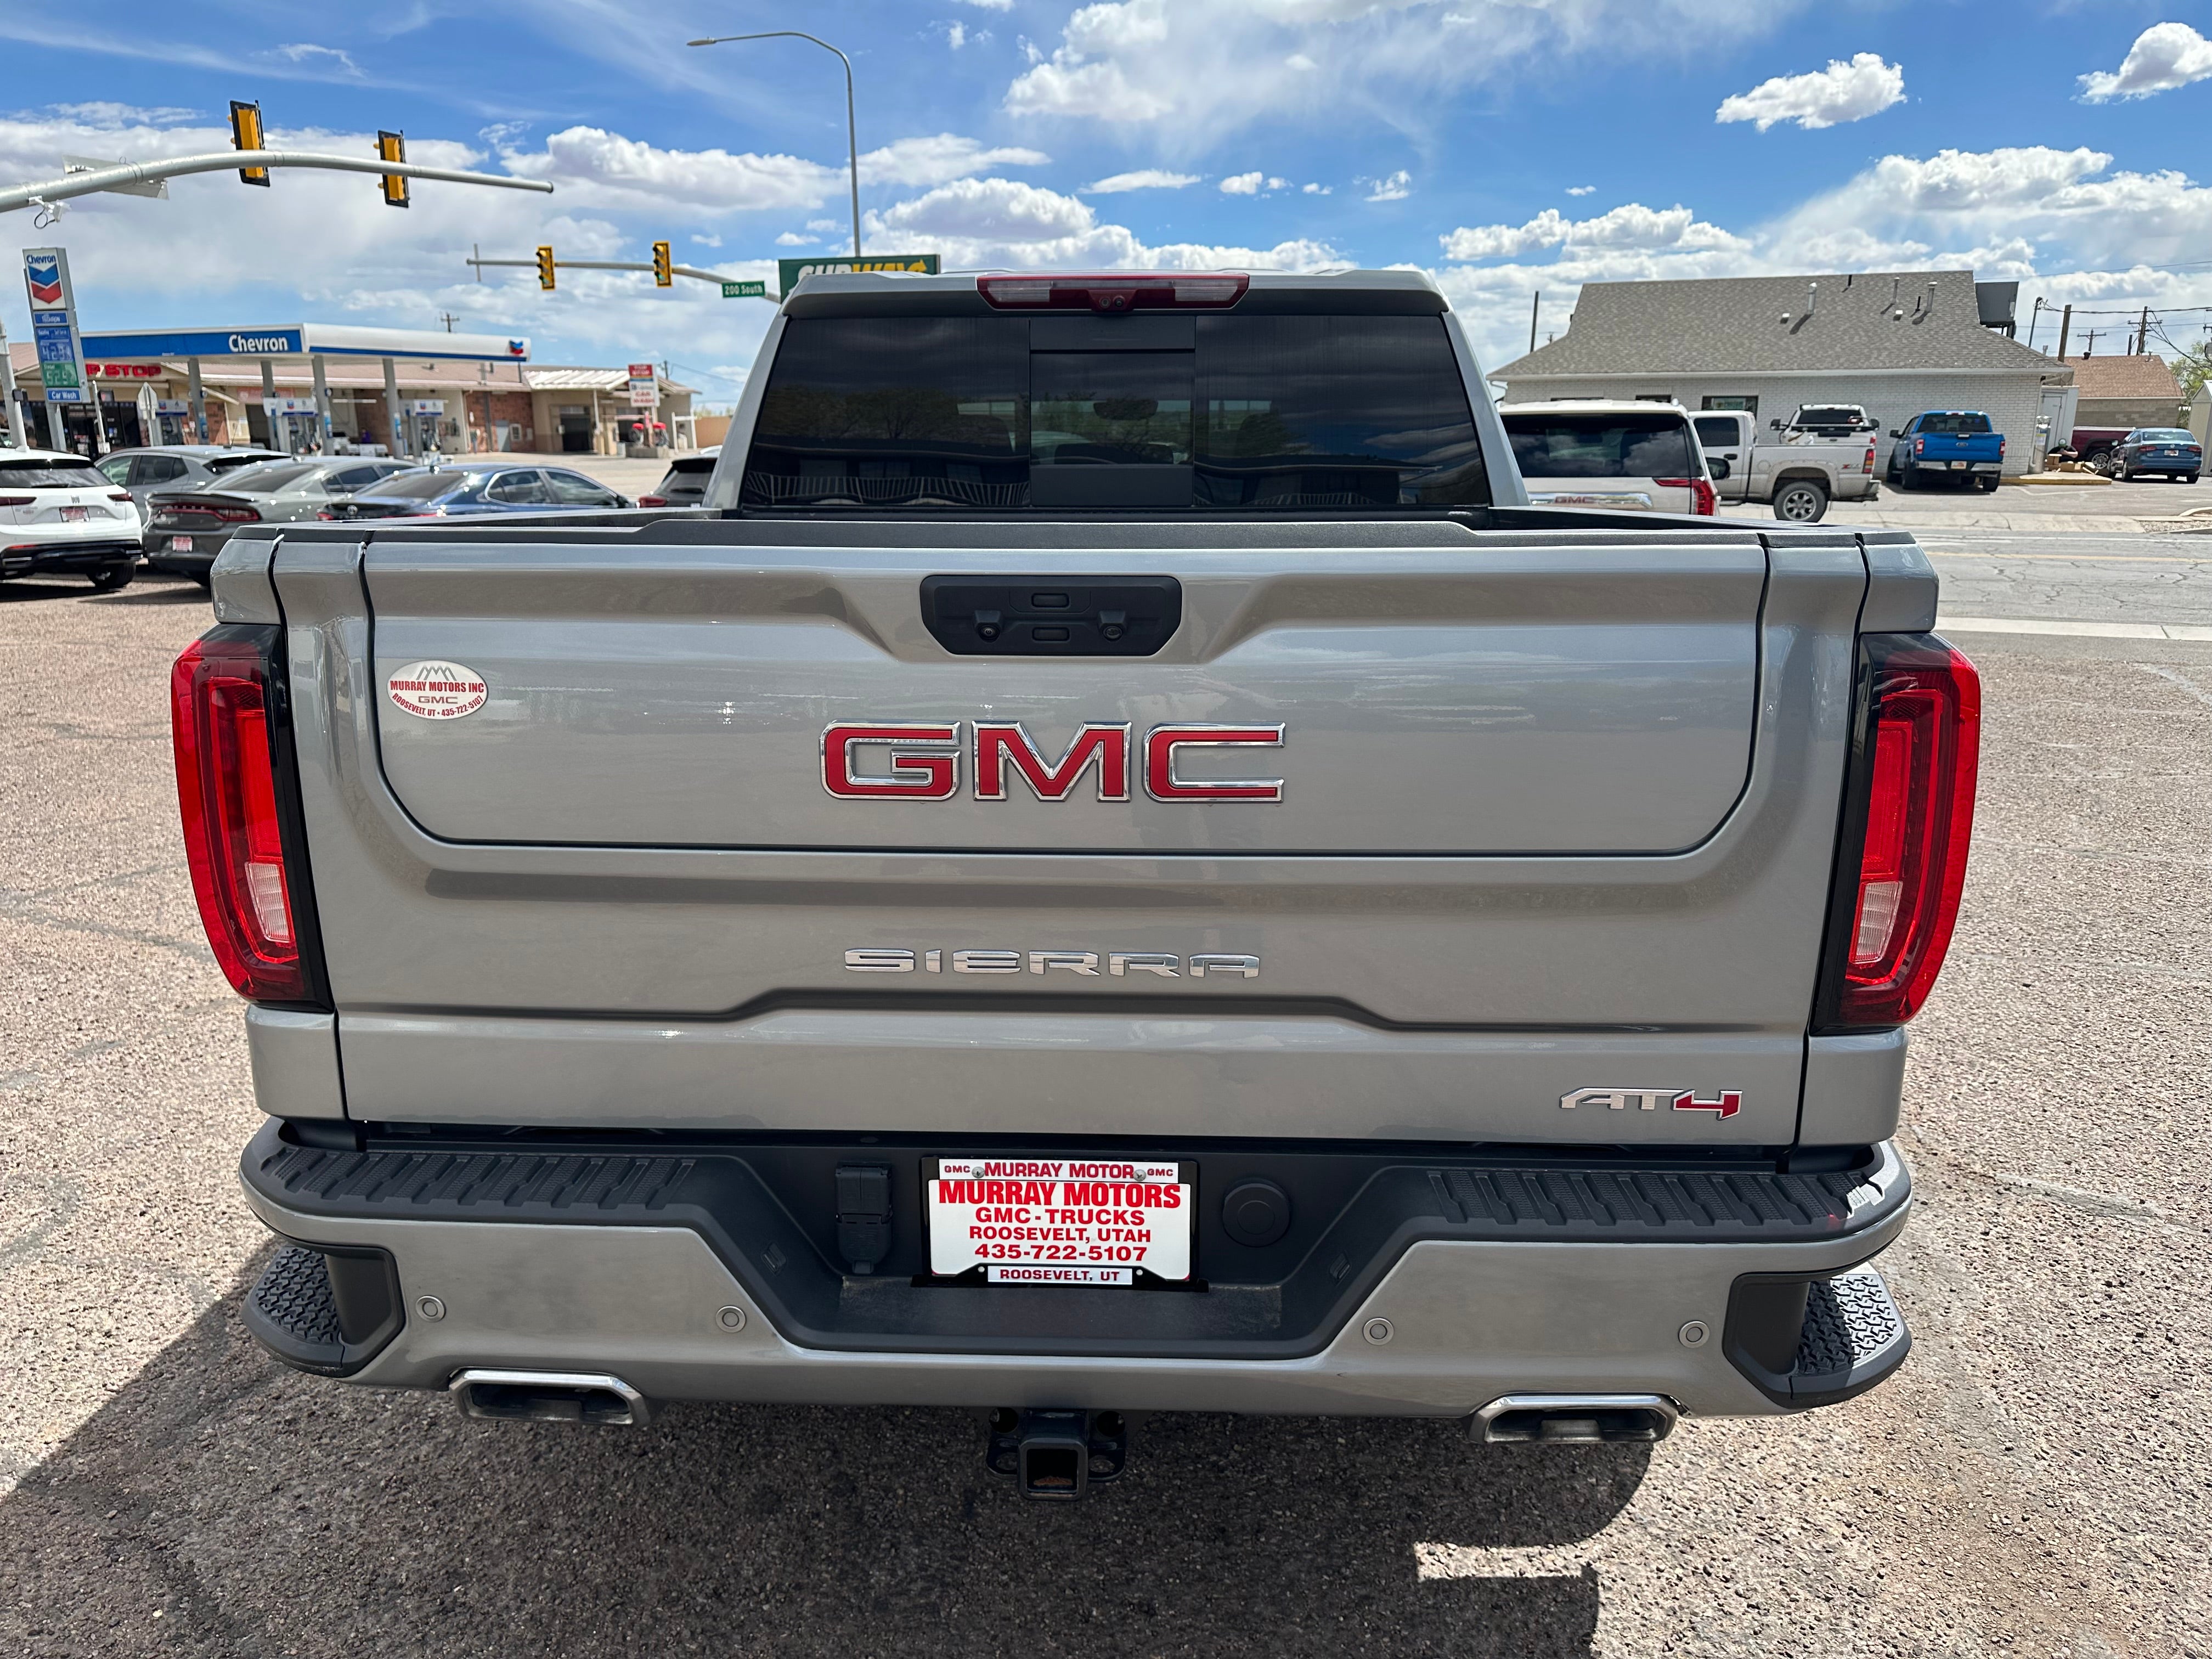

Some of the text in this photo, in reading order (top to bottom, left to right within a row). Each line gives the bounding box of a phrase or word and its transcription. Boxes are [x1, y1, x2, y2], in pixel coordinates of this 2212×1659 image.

[26, 255, 57, 264] Chevron
[725, 284, 763, 295] 200 South
[229, 334, 288, 352] Chevron
[104, 363, 161, 377] STOP
[52, 391, 77, 399] Car Wash
[390, 680, 484, 693] MURRAY MOTORS INC
[392, 692, 426, 716] ROOSEVELT,
[442, 695, 484, 716] 435-722-5107
[418, 696, 458, 704] GMC
[819, 720, 1285, 803] GMC
[844, 948, 1260, 979] SIERRA
[1560, 1087, 1742, 1120] AT4
[984, 1162, 1063, 1178] MURRAY
[1069, 1163, 1133, 1178] MOTOR
[1147, 1169, 1173, 1177] GMC
[939, 1180, 1181, 1208] MURRAY MOTORS
[969, 1226, 1151, 1244] ROOSEVELT, UTAH
[974, 1244, 1147, 1261] 435-722-5107
[1000, 1269, 1120, 1281] ROOSEVELT, UT
